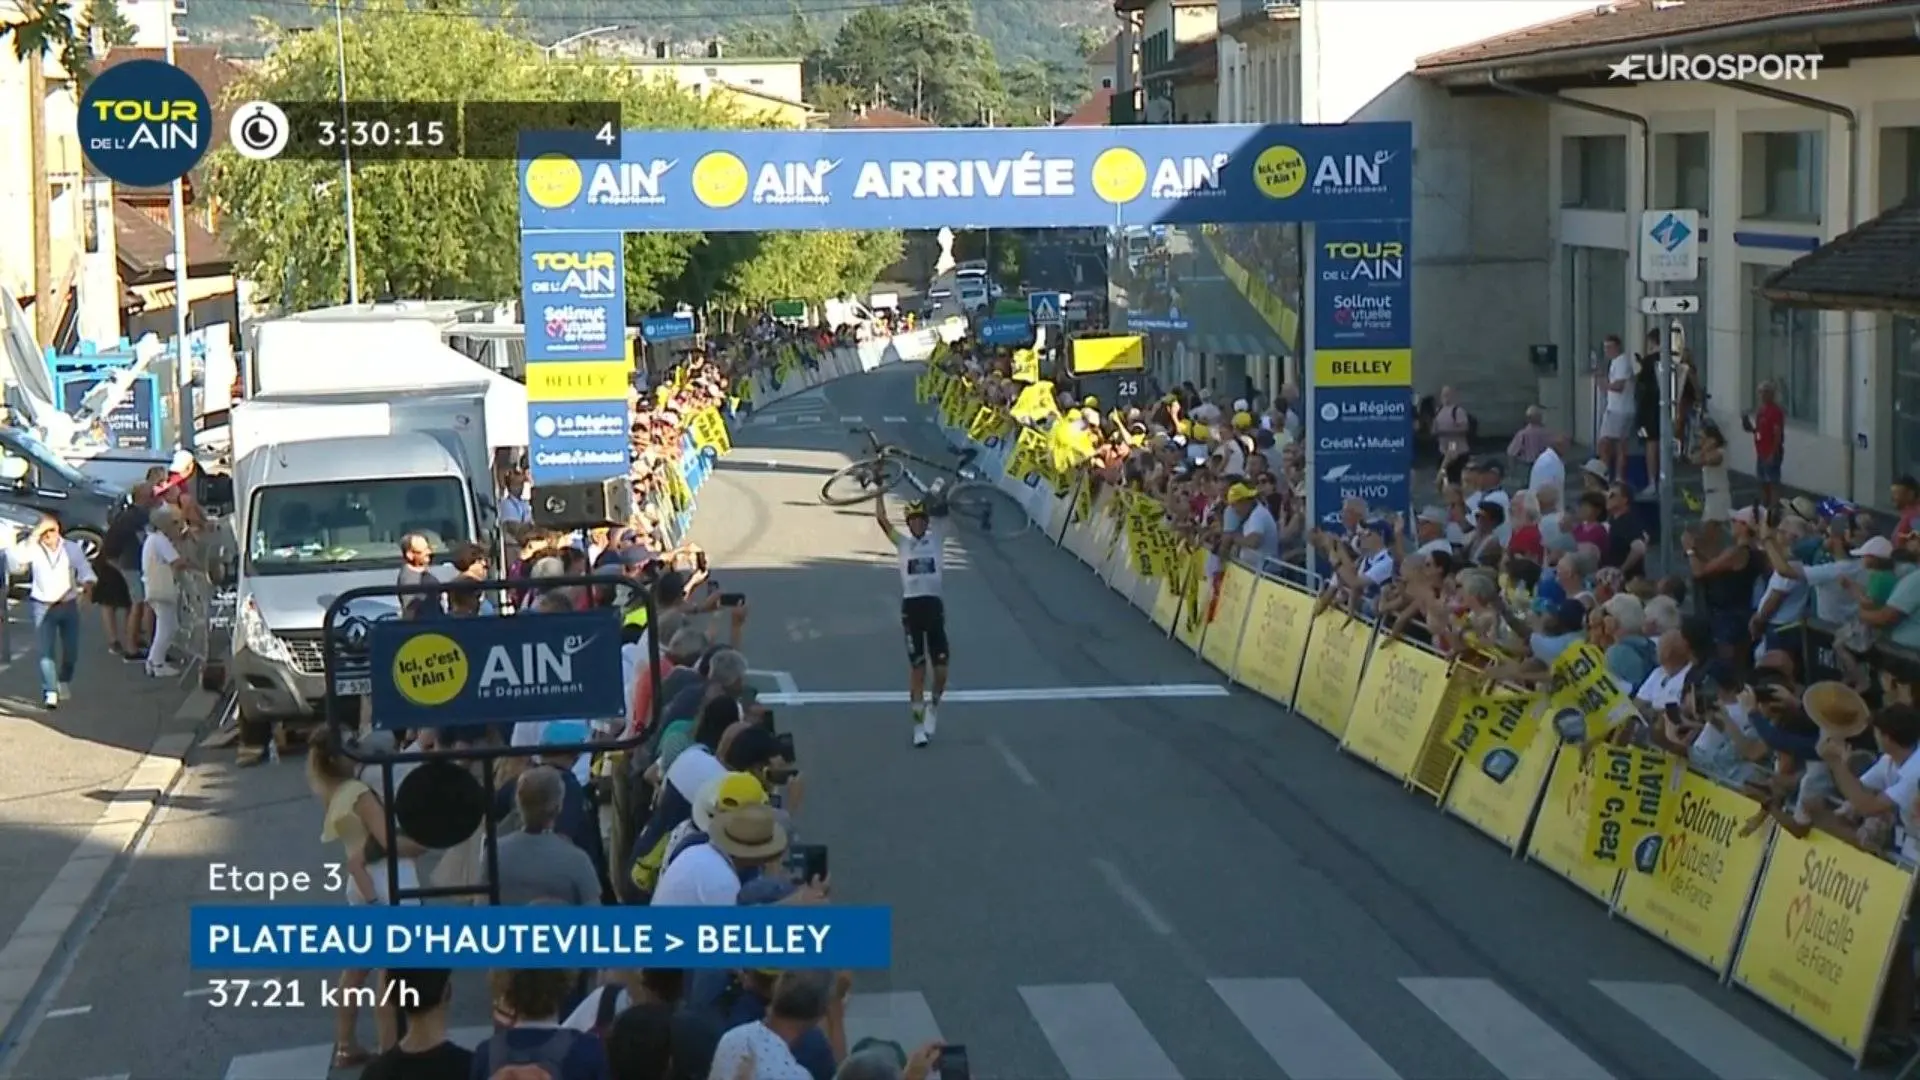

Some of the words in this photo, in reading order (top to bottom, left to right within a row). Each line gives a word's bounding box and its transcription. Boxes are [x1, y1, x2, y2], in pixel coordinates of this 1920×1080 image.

[588, 162, 658, 196] AIN
[754, 161, 823, 197] AIN
[853, 151, 1075, 198] ARRIVÉE
[1152, 157, 1220, 191] AIN
[1312, 155, 1381, 187] AIN
[532, 251, 615, 272] TOUR
[1323, 242, 1403, 259] TOUR
[1322, 271, 1338, 281] DE
[1332, 361, 1392, 374] BELLEY
[1119, 381, 1137, 396] 25
[1342, 401, 1357, 413] La
[1360, 400, 1404, 415] Région
[1360, 485, 1388, 498] HVO
[399, 659, 422, 675] Ici,
[426, 650, 461, 668] c'est
[479, 643, 573, 687] AIN
[411, 671, 444, 689] l'Ain
[477, 686, 491, 698] le
[496, 683, 584, 698] Département
[1675, 790, 1738, 849] Solimut
[1798, 848, 1870, 915] Solimut
[1807, 947, 1844, 986] France
